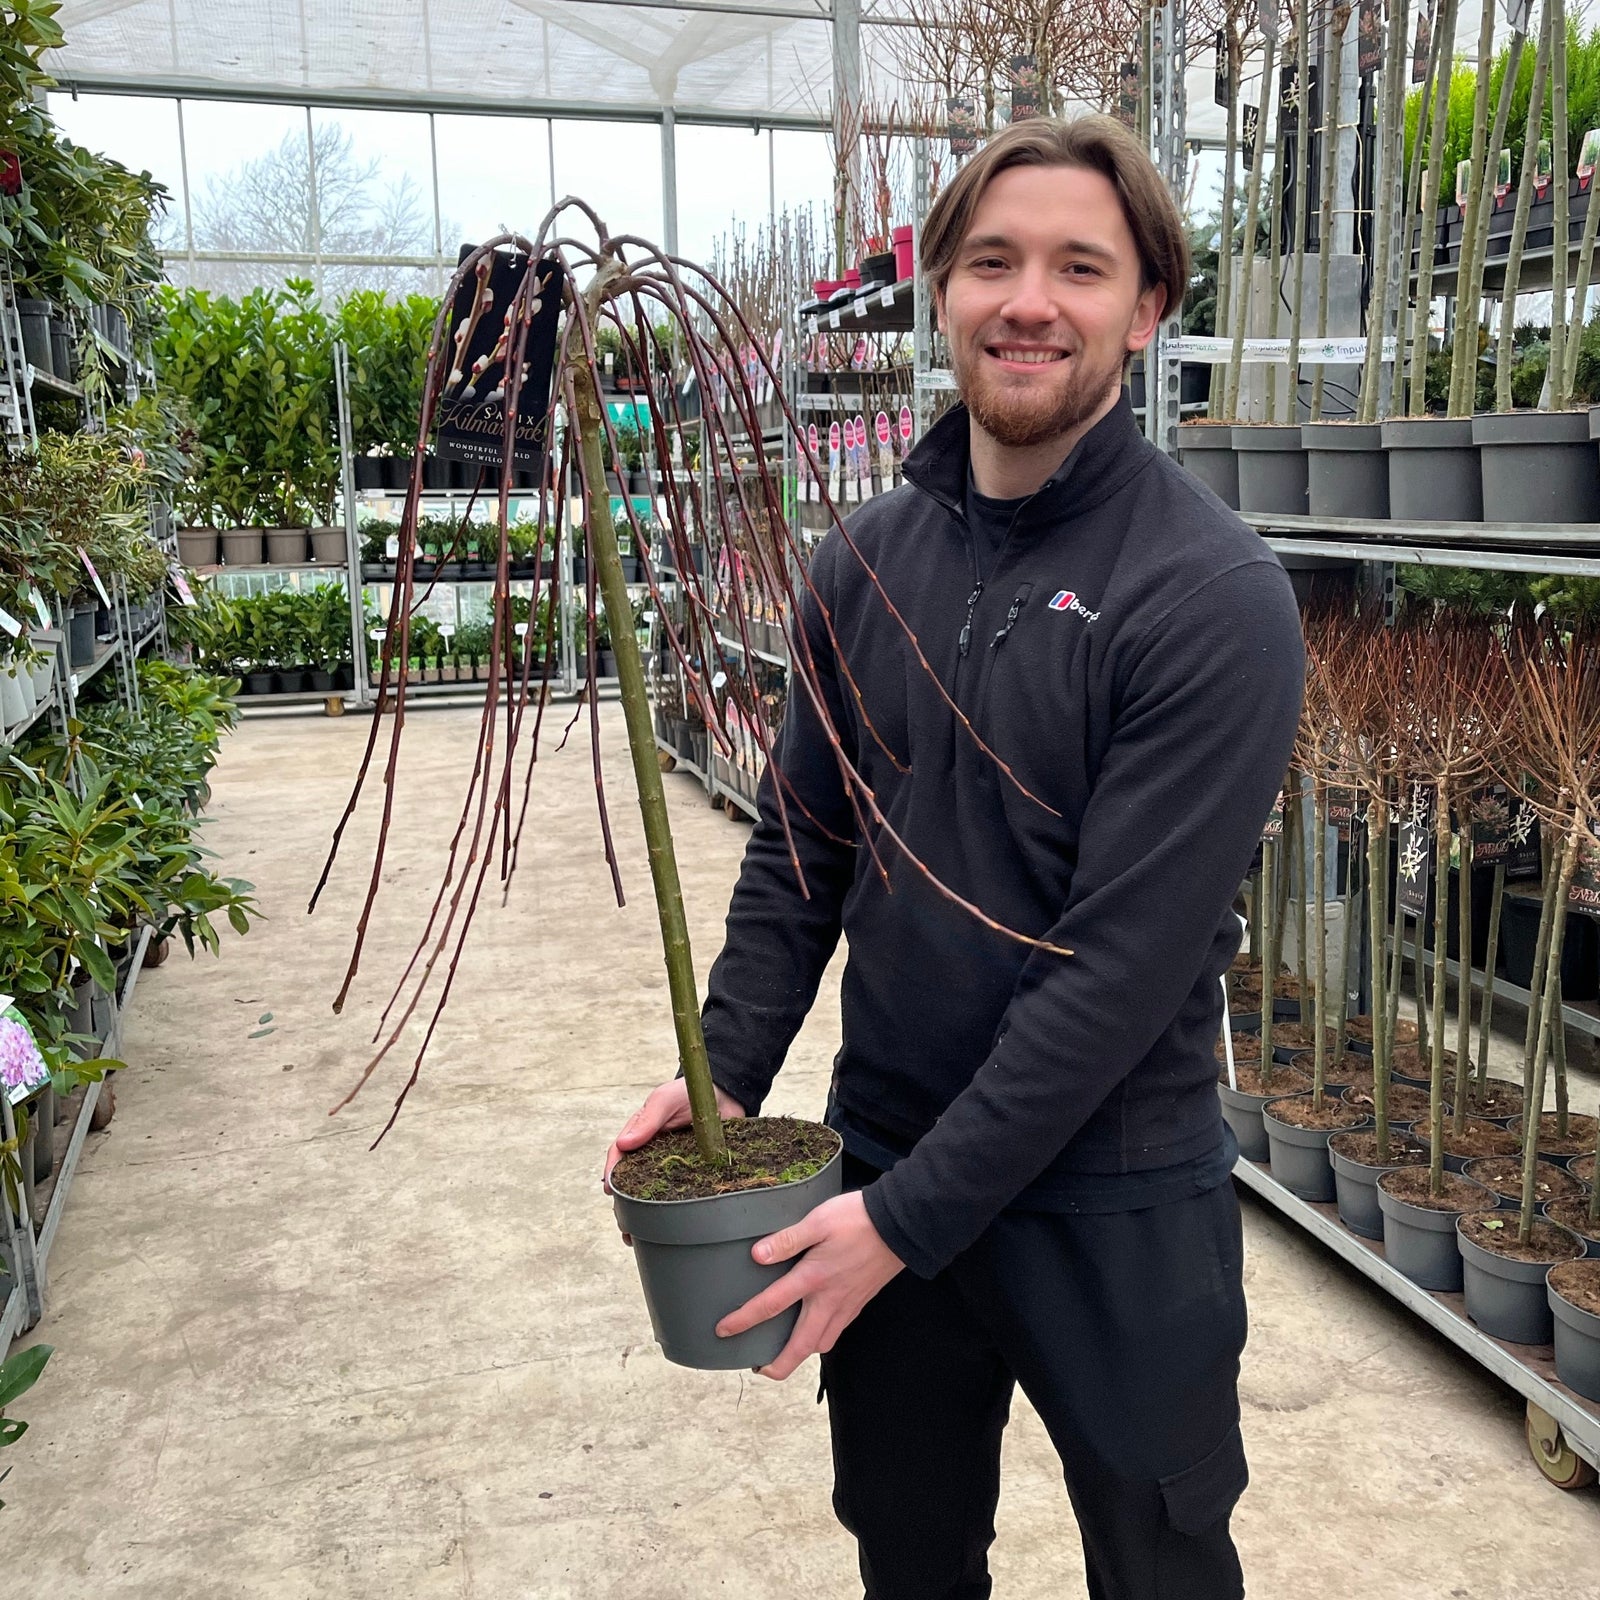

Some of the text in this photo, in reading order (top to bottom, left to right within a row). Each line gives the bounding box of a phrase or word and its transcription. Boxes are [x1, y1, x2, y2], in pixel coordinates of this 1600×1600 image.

[439, 398, 549, 442] Kilmarock
[484, 407, 534, 425] SAIX
[449, 442, 530, 460] WONDERFUL RLD
[478, 455, 503, 464] WILLO
